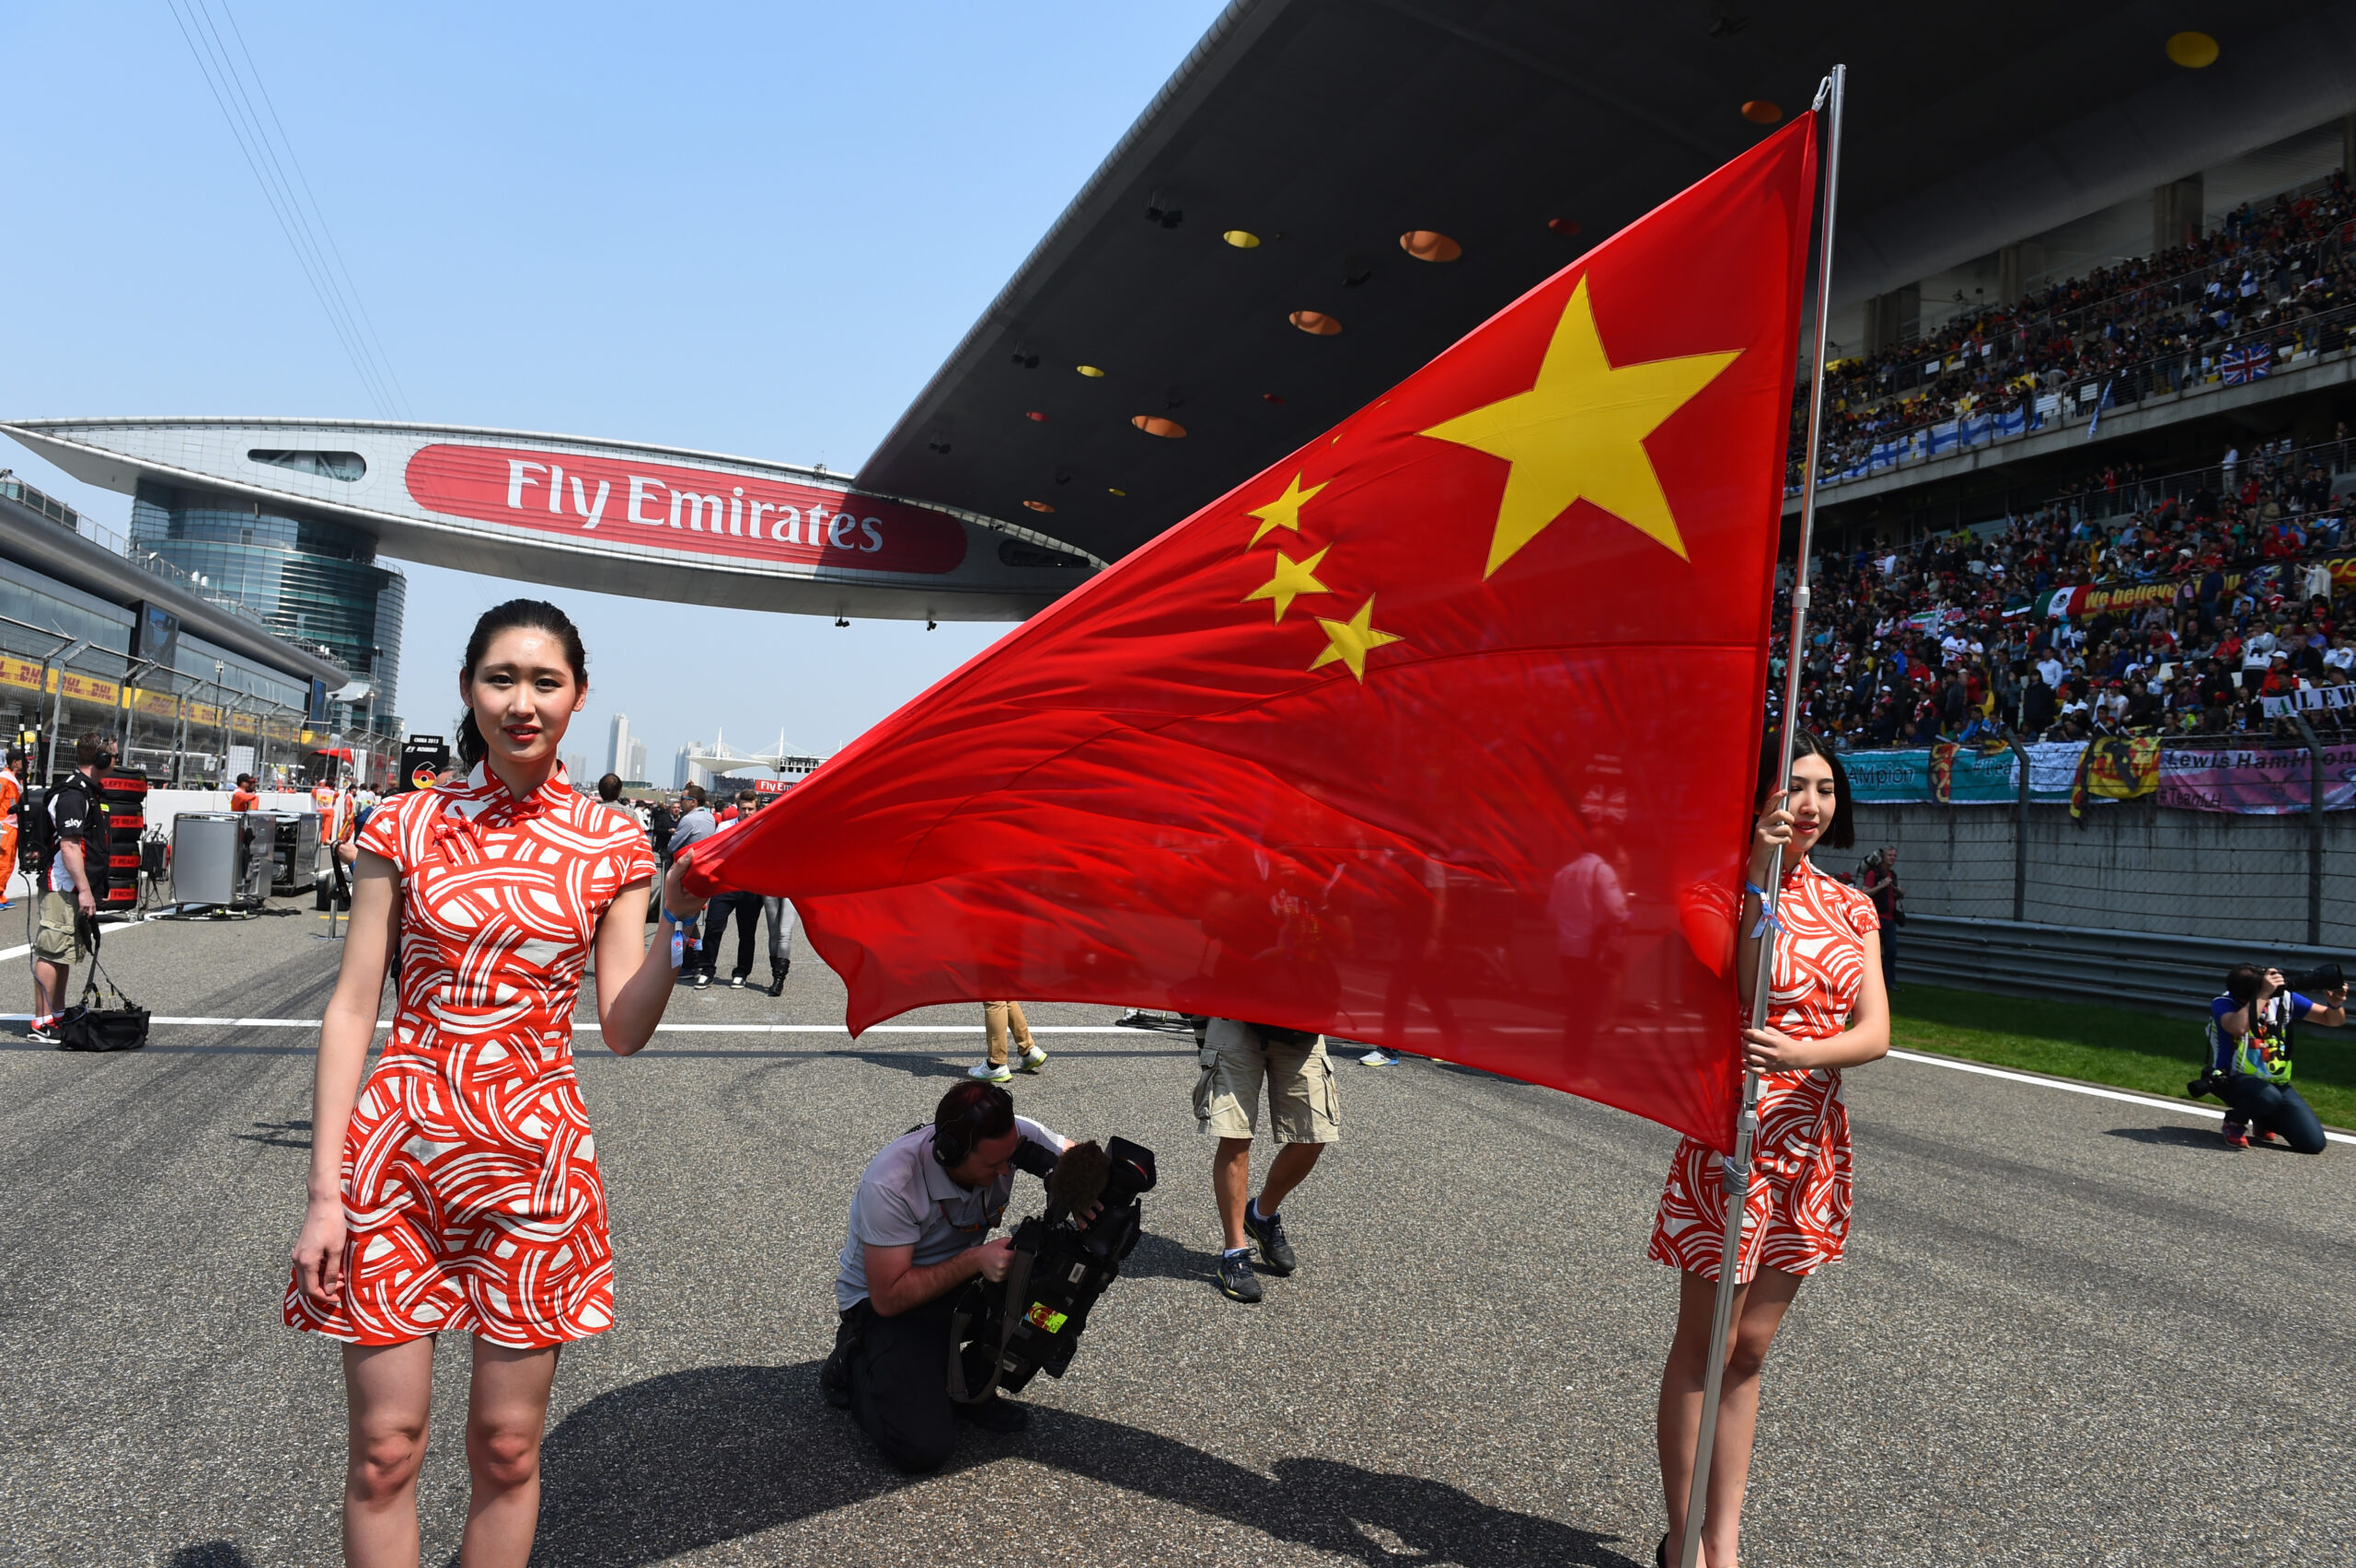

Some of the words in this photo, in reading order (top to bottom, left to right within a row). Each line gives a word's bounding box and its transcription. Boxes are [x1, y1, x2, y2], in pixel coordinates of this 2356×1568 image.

[507, 459, 610, 529] Fly
[628, 474, 884, 553] Emirates
[2085, 589, 2110, 609] We
[2167, 750, 2230, 769] Lewis
[2236, 750, 2353, 770] Hamilon
[104, 780, 121, 789] LEFT
[412, 761, 436, 790] 6
[760, 780, 776, 791] Fly
[1845, 762, 1915, 790] AMpion
[64, 817, 83, 828] sky
